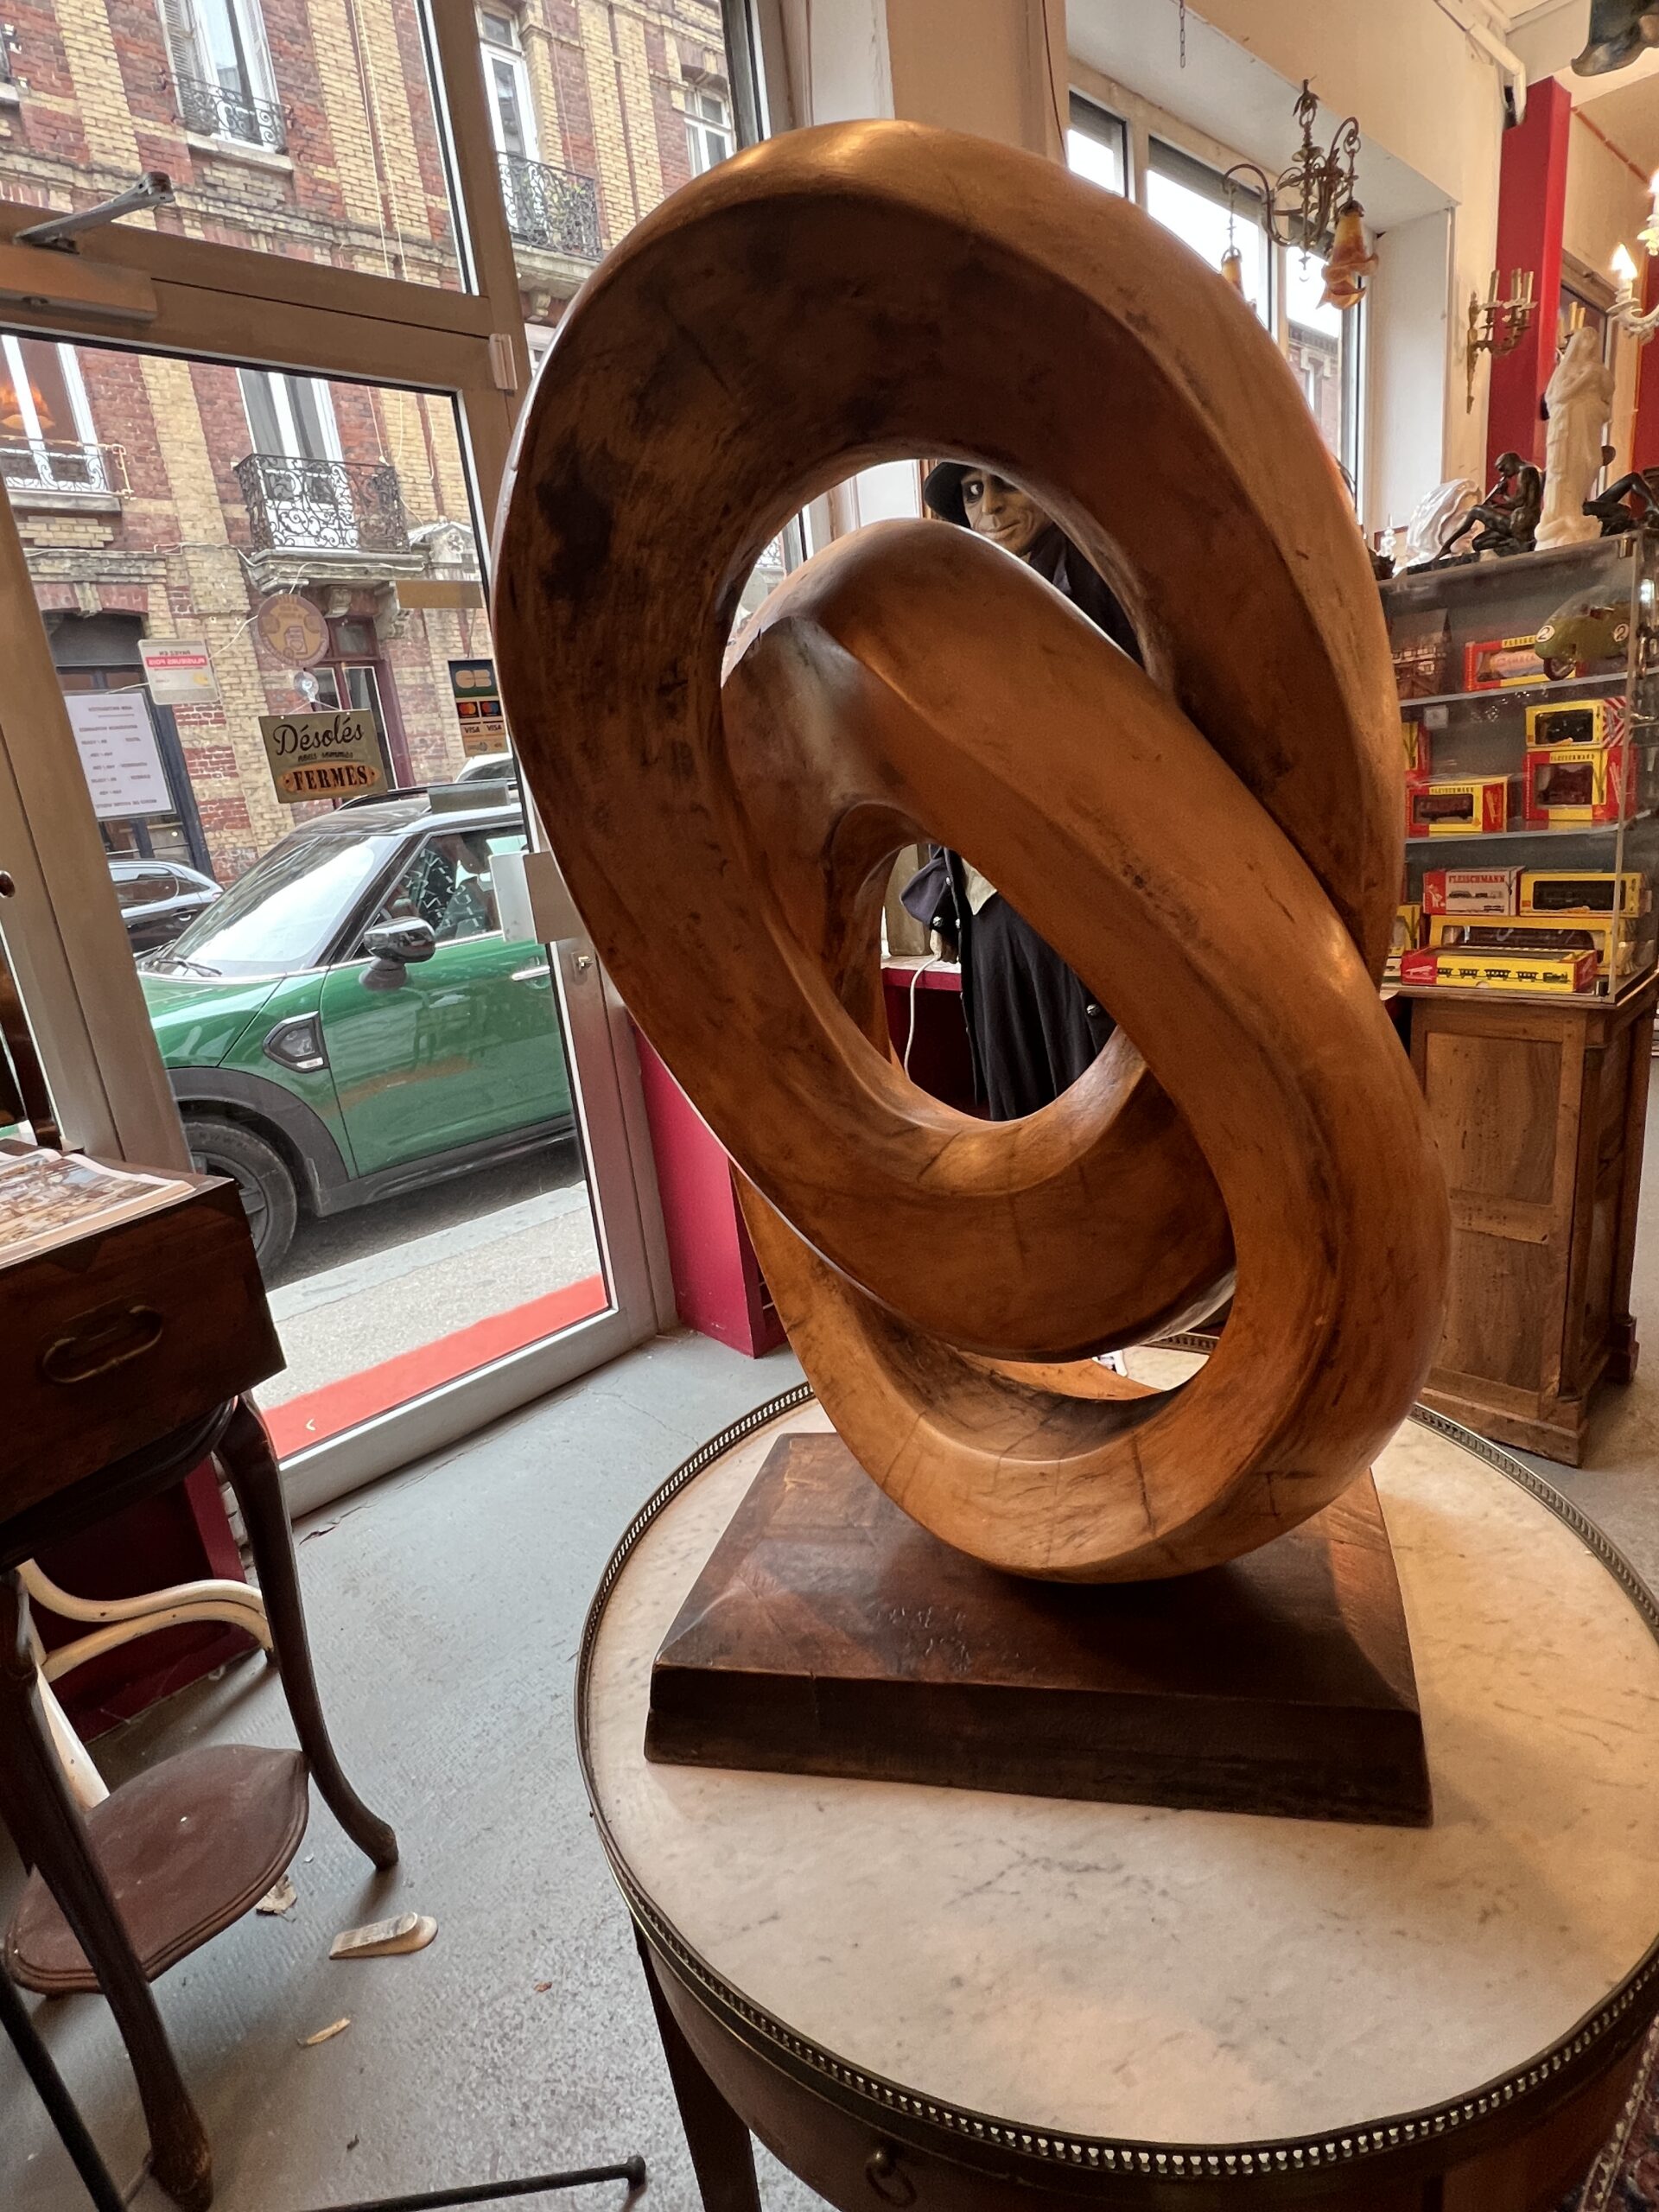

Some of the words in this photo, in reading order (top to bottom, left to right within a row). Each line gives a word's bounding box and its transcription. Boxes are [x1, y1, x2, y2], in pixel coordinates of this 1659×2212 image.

[1537, 626, 1551, 641] 2
[1617, 626, 1626, 640] 2
[272, 715, 364, 756] Désolés
[1448, 874, 1505, 884] FLEISCHMANN
